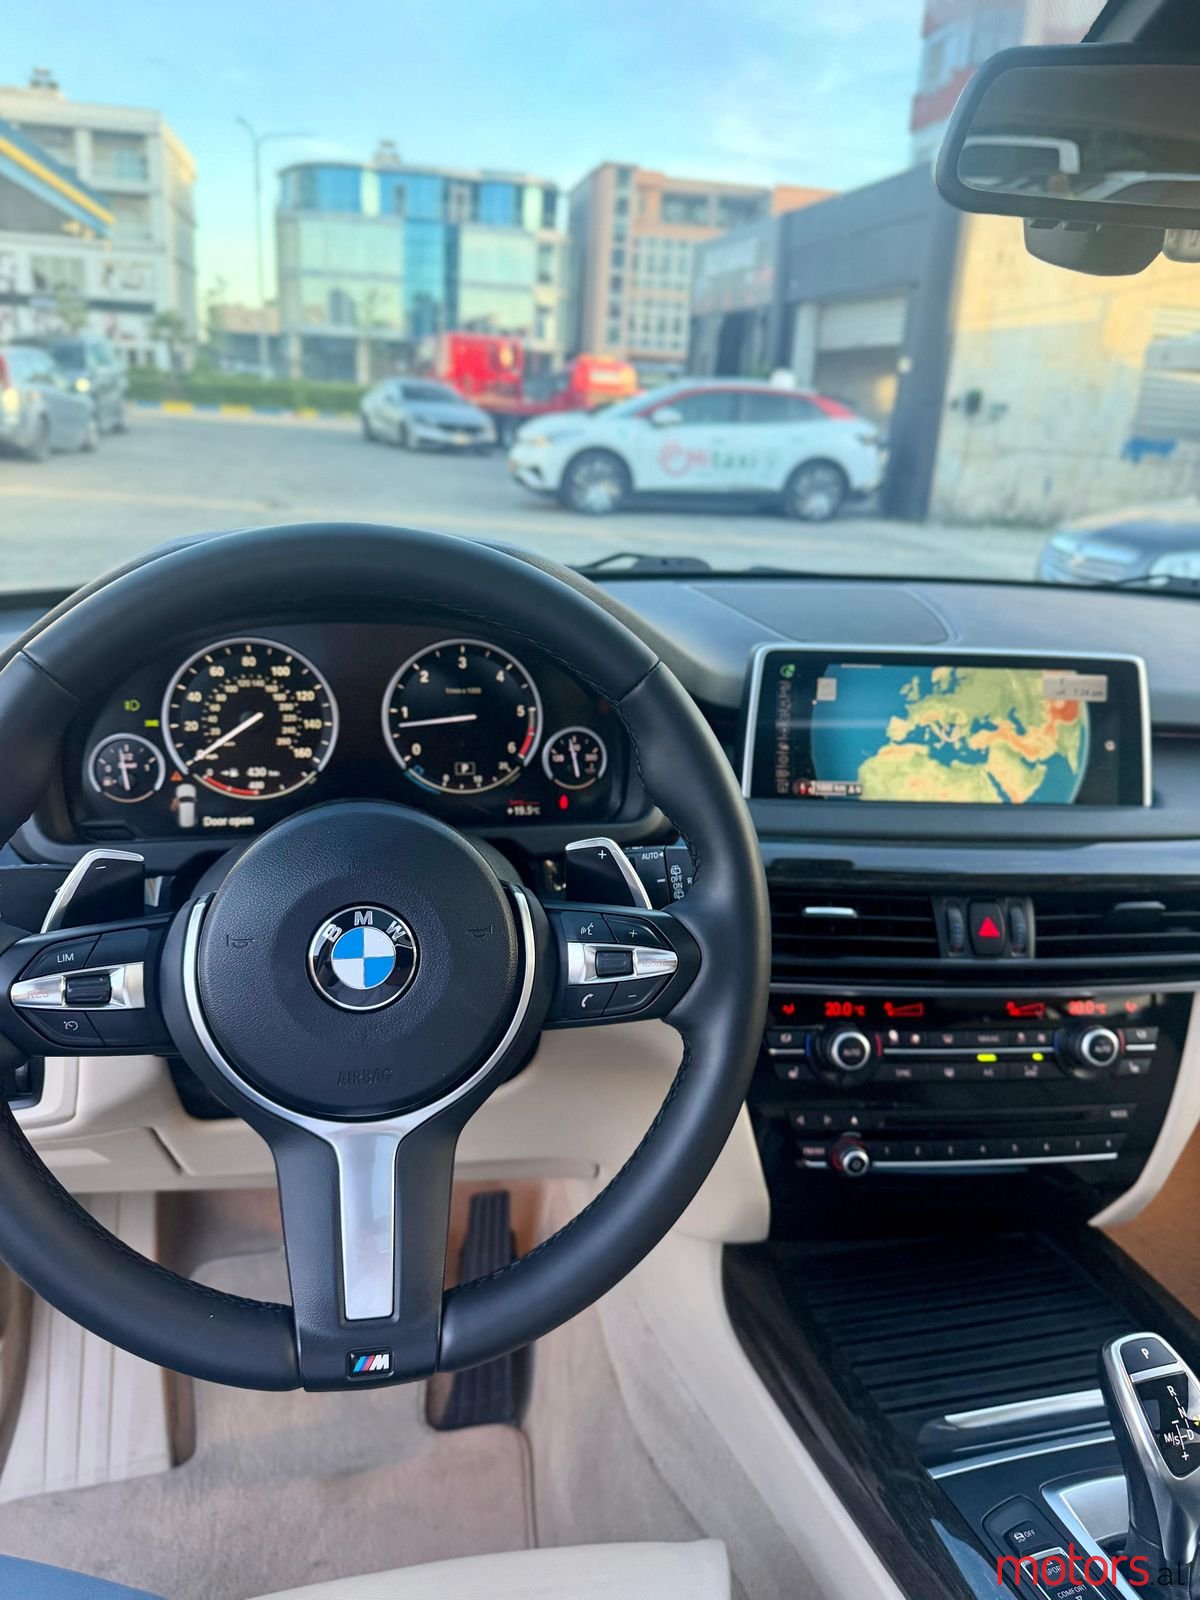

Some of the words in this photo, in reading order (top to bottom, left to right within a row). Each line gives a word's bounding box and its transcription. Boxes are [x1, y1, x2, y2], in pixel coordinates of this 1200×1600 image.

[458, 656, 468, 670] 3
[209, 666, 225, 677] 60
[271, 666, 291, 677] 100
[419, 669, 430, 684] 2
[495, 669, 505, 683] 4
[187, 691, 202, 702] 40
[295, 690, 316, 702] 120
[401, 706, 409, 719] 1
[516, 705, 526, 717] 5
[184, 720, 199, 732] 20
[303, 719, 322, 730] 140
[411, 742, 422, 756] 0
[507, 741, 517, 754] 6
[203, 816, 228, 827] Door
[228, 816, 255, 827] open
[641, 851, 659, 860] AUTO
[670, 874, 683, 883] OFF
[322, 910, 406, 943] BMW
[57, 953, 75, 963] LIM
[337, 1067, 393, 1088] AIRBAG
[1141, 1348, 1150, 1359] P
[1167, 1385, 1177, 1397] R
[1178, 1406, 1187, 1418] N
[1187, 1432, 1195, 1441] D
[1023, 1529, 1036, 1539] OFF
[1057, 1584, 1087, 1600] COMFORT
